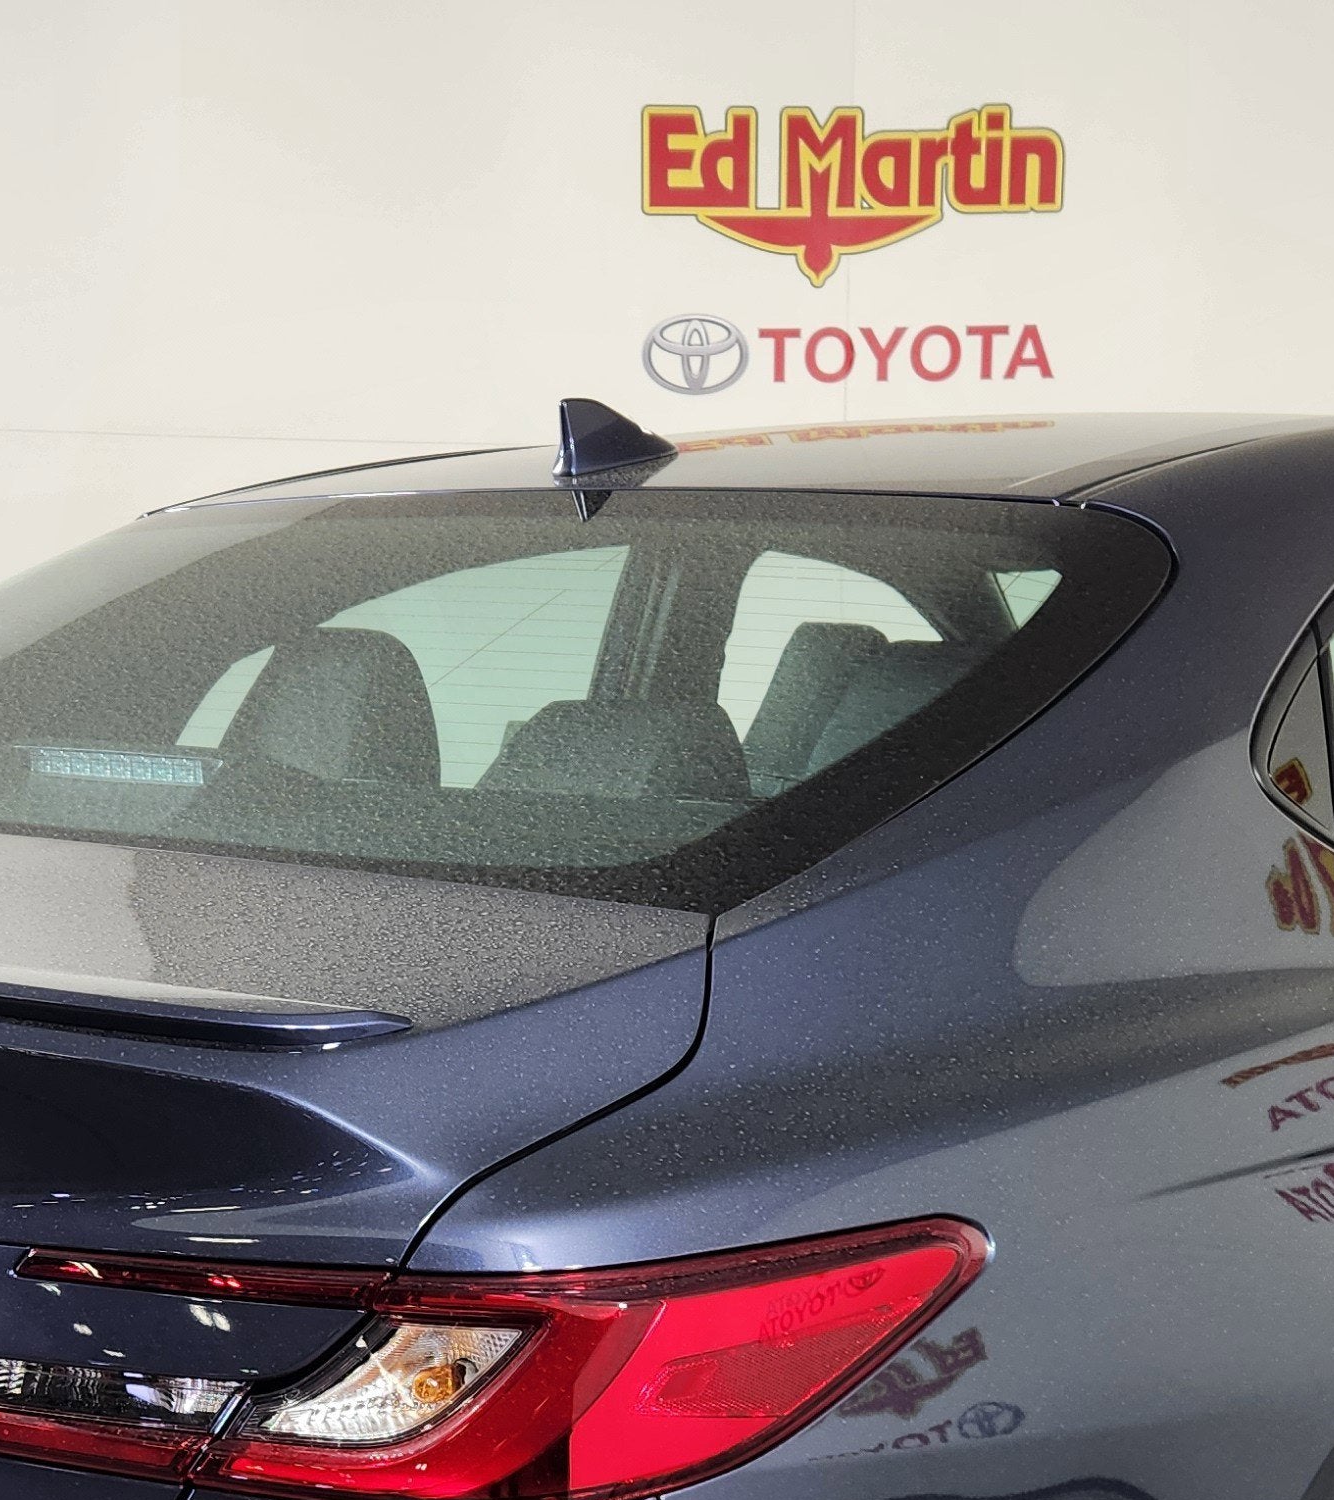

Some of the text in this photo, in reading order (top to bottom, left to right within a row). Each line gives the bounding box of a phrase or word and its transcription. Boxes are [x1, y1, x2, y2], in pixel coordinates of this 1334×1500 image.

[643, 104, 1064, 213] Ed Martin
[758, 324, 1054, 384] TOYOTA
